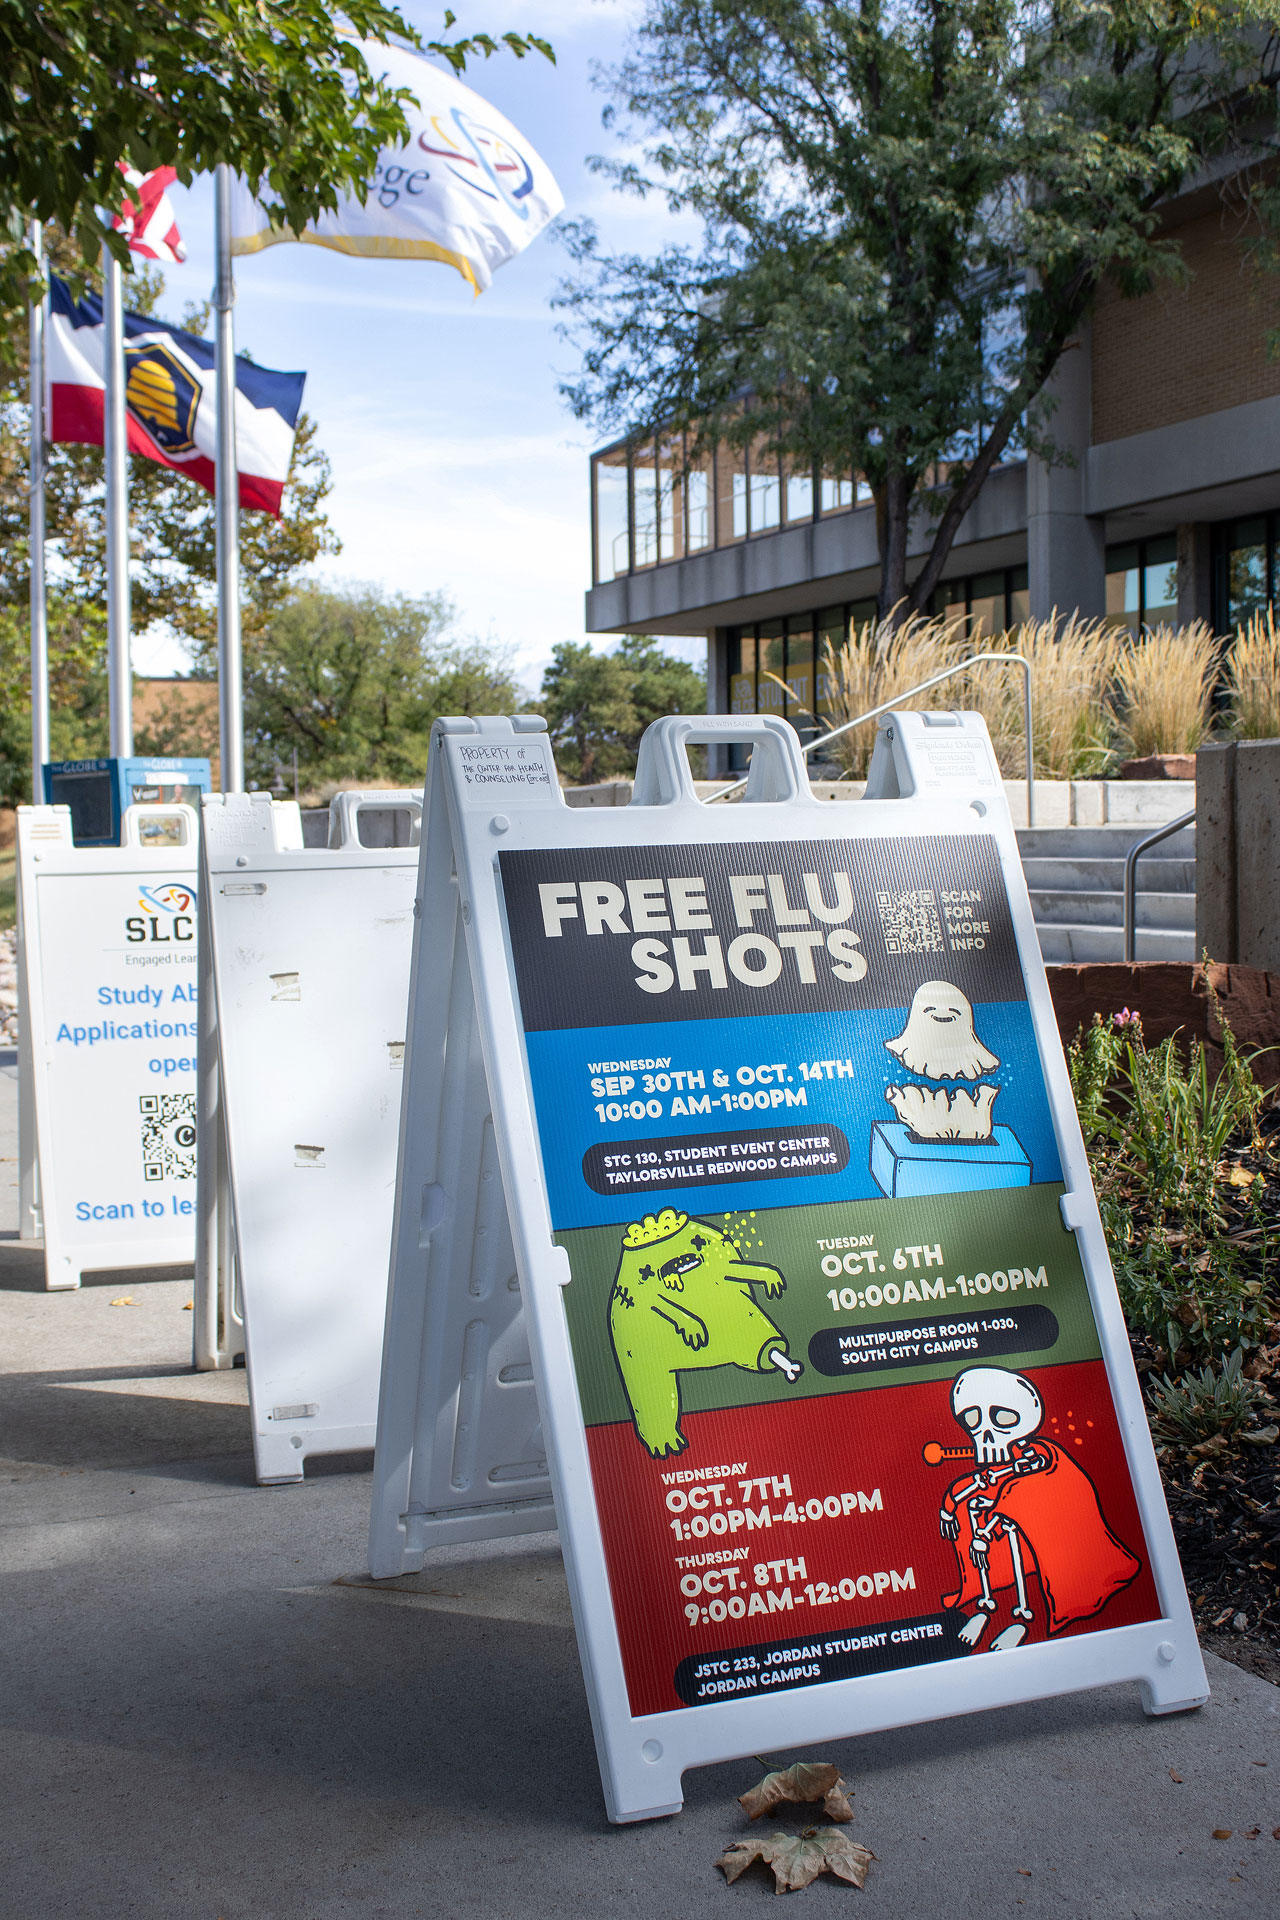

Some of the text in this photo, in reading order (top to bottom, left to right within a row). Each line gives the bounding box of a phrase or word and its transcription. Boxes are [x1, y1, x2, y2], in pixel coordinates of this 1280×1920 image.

[62, 761, 97, 773] GLOBE
[460, 746, 510, 761] PROPERTY
[462, 762, 544, 774] THE CENTER FOR HEALTH
[464, 774, 472, 784] &
[474, 773, 525, 783] COUNSELING
[538, 872, 854, 938] FREE FLU
[940, 890, 982, 902] SCAN
[944, 906, 973, 919] FOR
[126, 916, 193, 942] SLC
[947, 921, 991, 935] MORE
[950, 937, 986, 951] INFO
[125, 954, 171, 967] Engaged
[631, 929, 868, 994] SHOTS
[98, 984, 163, 1008] Study
[56, 1019, 197, 1046] Applications
[587, 1057, 672, 1074] WEDNESDAY
[590, 1059, 855, 1097] SEP 30TH & OCT. 14TH
[594, 1087, 808, 1123] 10:00 AM-1:00PM
[604, 1136, 830, 1168] STC 130, STUDENT EVENT CENTER
[606, 1152, 838, 1185] TAYLORSVILLE REDWOOD CAMPUS
[76, 1195, 196, 1221] Scan to le
[817, 1234, 875, 1251] TUESDAY
[820, 1243, 944, 1278] OCT. 6TH
[826, 1265, 1049, 1312] 10:00AM-1:00PM
[839, 1317, 1018, 1349] MULTIPURPOSE ROOM 1-030,
[841, 1338, 979, 1365] SOUTH CITY CAMPUS
[661, 1462, 748, 1486] WEDNESDAY
[665, 1474, 793, 1513] OCT. 7TH
[669, 1488, 884, 1541] 1:00PM-4:00PM
[675, 1547, 750, 1569] THURSDAY
[680, 1556, 808, 1597] OCT. 8TH
[684, 1567, 917, 1626] 9:00AM-12:00PM
[694, 1623, 944, 1678] JSTC 233, JORDAN STUDENT CENTER
[697, 1664, 821, 1697] JORDAN CAMPUS
